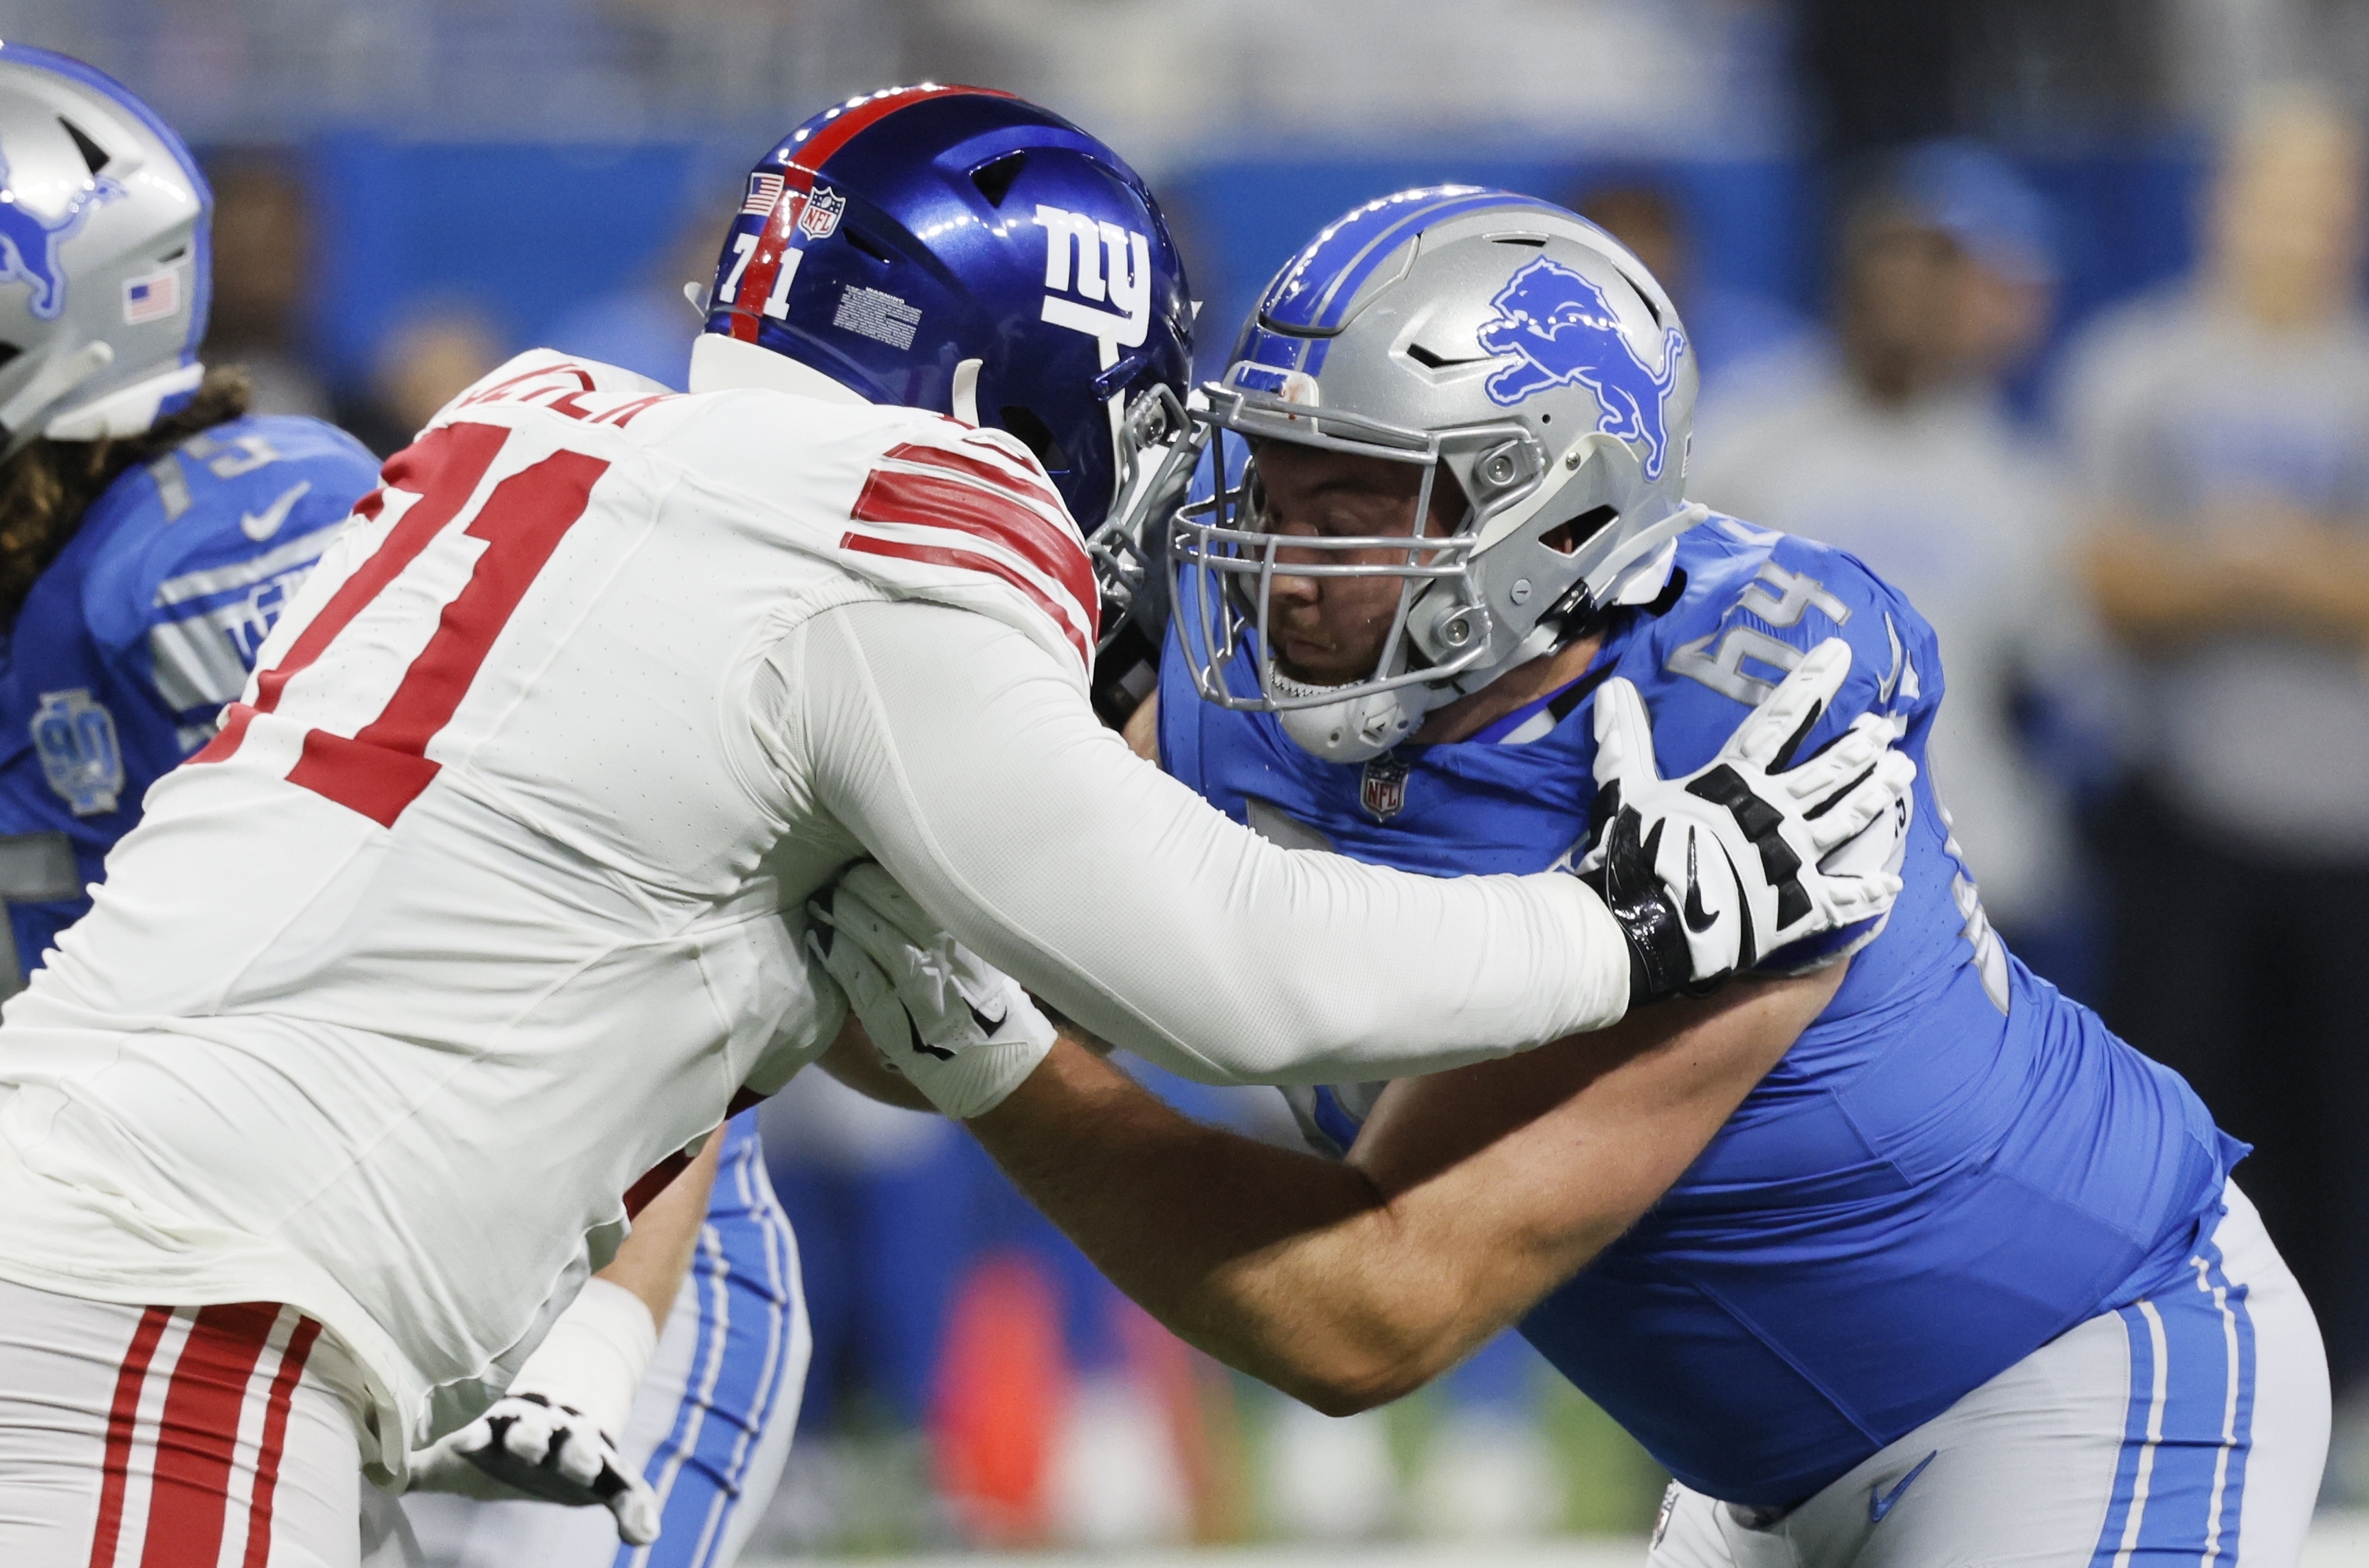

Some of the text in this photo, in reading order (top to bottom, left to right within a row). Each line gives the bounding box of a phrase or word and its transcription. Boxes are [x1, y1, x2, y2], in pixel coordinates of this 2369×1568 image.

[803, 208, 831, 231] NFL
[720, 233, 803, 320] 71
[866, 286, 905, 304] WARNING
[183, 421, 610, 829] 71
[1665, 561, 1852, 708] 64
[1368, 781, 1397, 809] NFL
